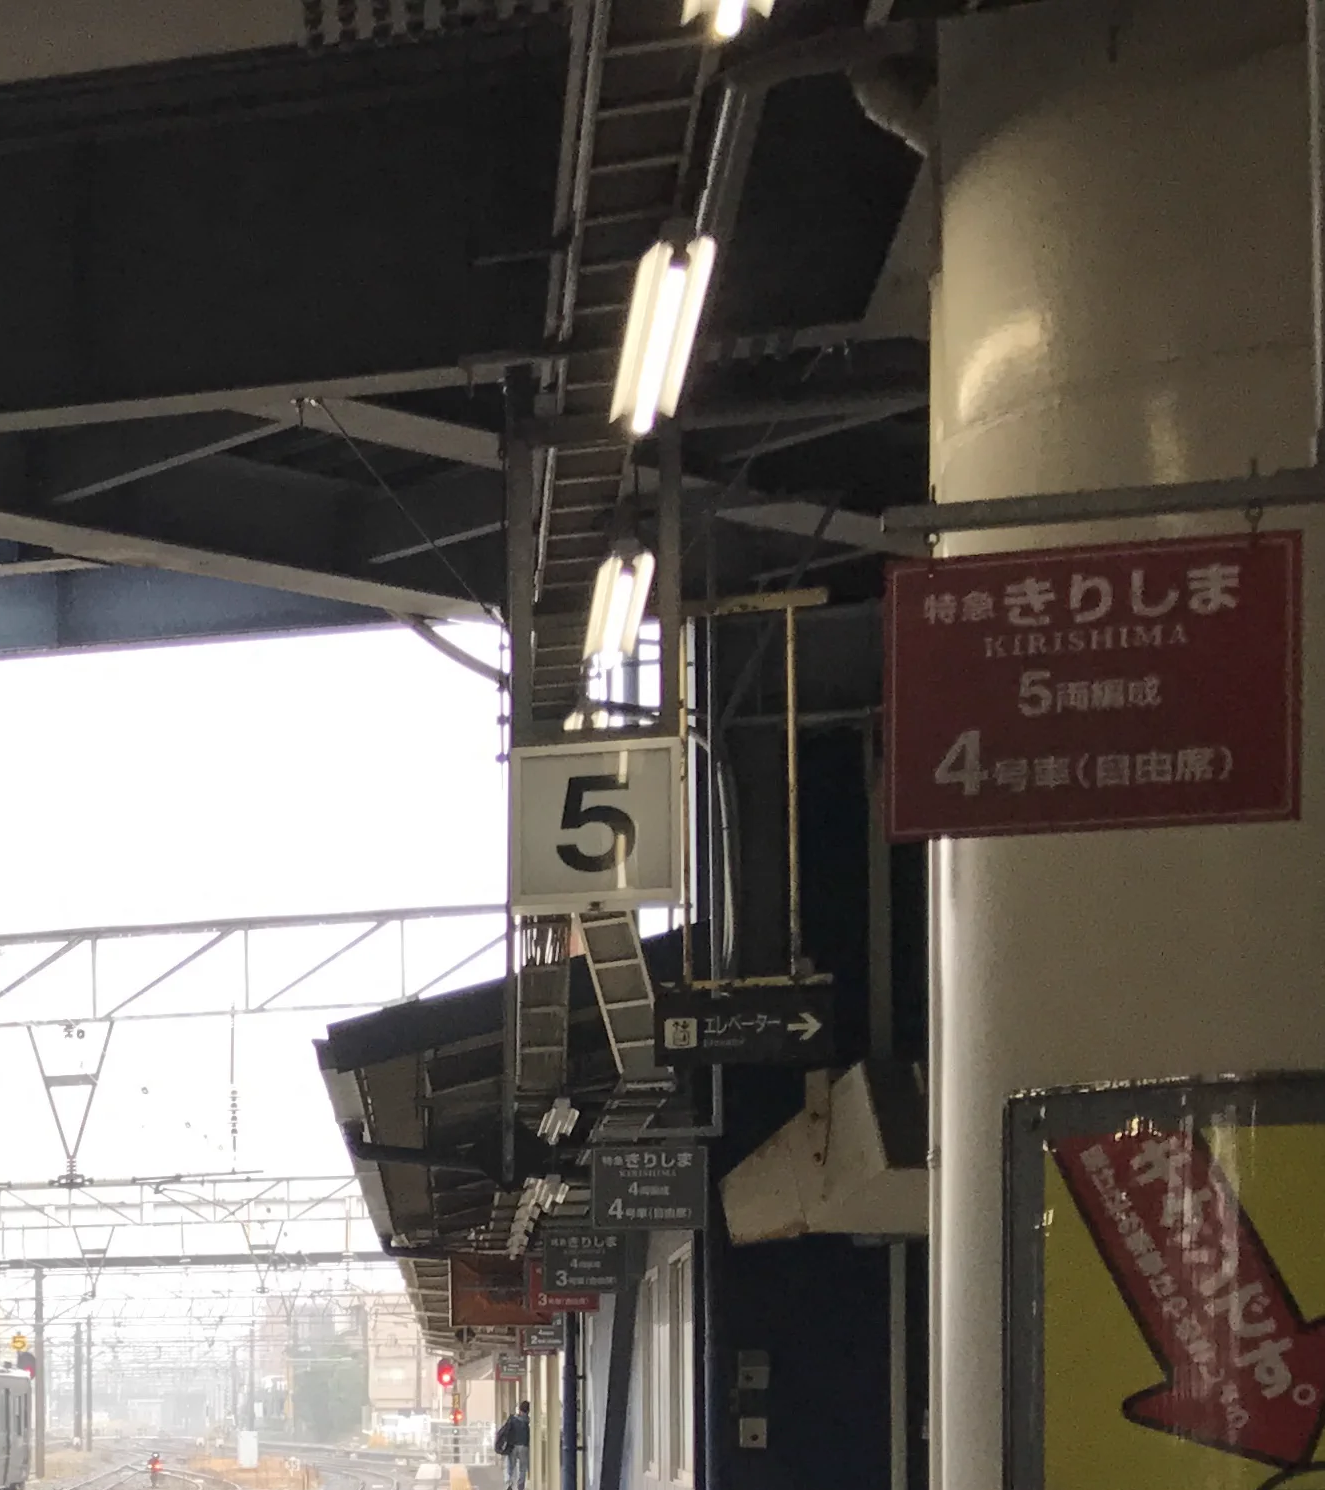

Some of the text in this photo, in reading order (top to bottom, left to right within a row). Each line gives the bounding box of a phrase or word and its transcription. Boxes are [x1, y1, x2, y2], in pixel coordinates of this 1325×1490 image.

[923, 563, 1241, 627] 特急きりしま
[983, 623, 1190, 658] KIRISHIMA
[555, 775, 636, 873] 5
[703, 1013, 782, 1036] エレベーター
[13, 1336, 26, 1350] 5
